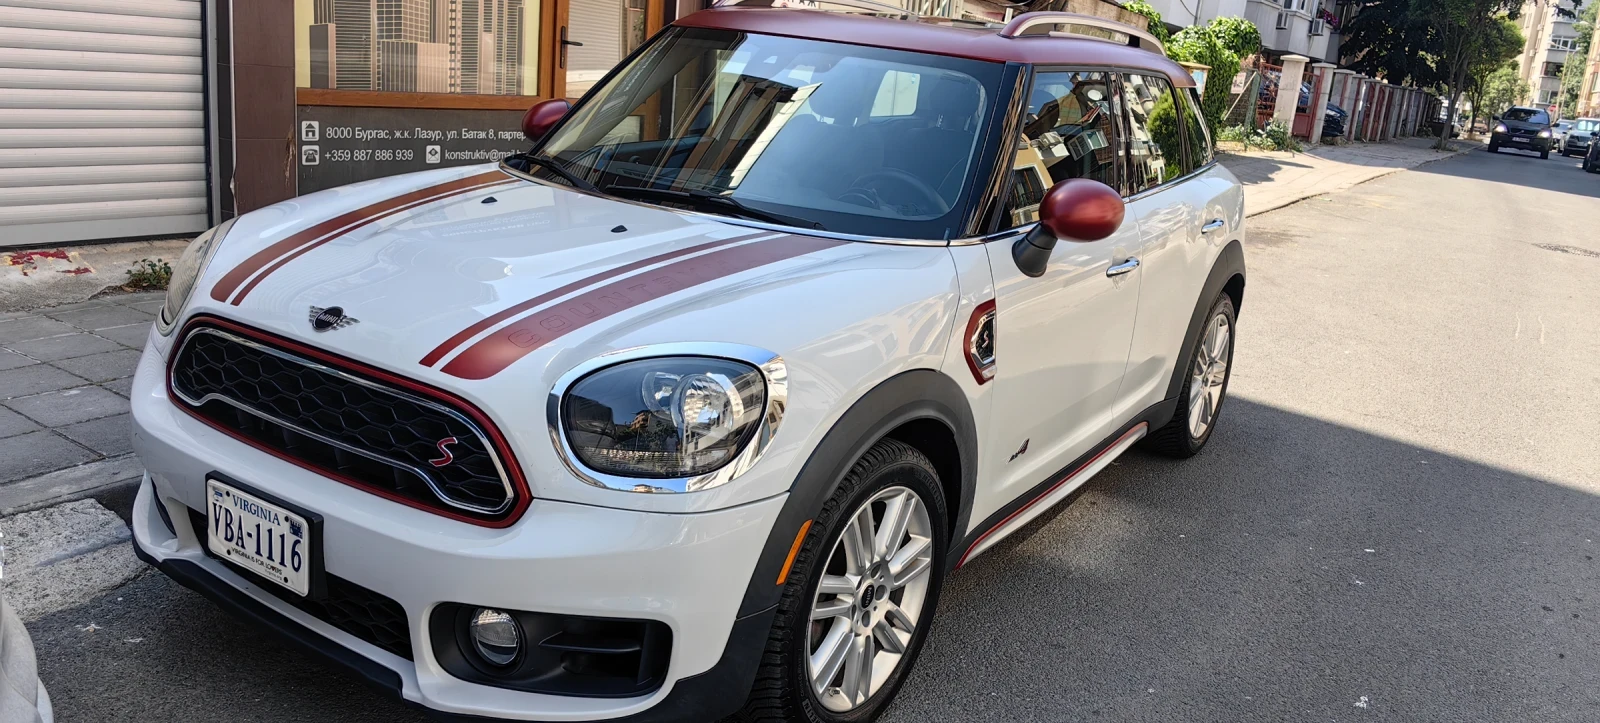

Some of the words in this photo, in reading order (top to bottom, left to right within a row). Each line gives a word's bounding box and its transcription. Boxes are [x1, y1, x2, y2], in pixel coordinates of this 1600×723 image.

[325, 127, 352, 139] 8000
[355, 127, 392, 141] Бургас,
[394, 130, 412, 139] ж.к.
[414, 127, 444, 141] Лазур,
[446, 130, 459, 141] ул.
[462, 128, 487, 139] Батак
[488, 128, 497, 140] 8,
[325, 149, 351, 161] +359
[353, 149, 373, 161] 887
[375, 149, 393, 161] 886
[395, 149, 414, 161] 939
[317, 312, 339, 324] MINI
[428, 436, 458, 467] S
[232, 494, 281, 526] VIRGINIA
[212, 501, 302, 573] VBA-1116
